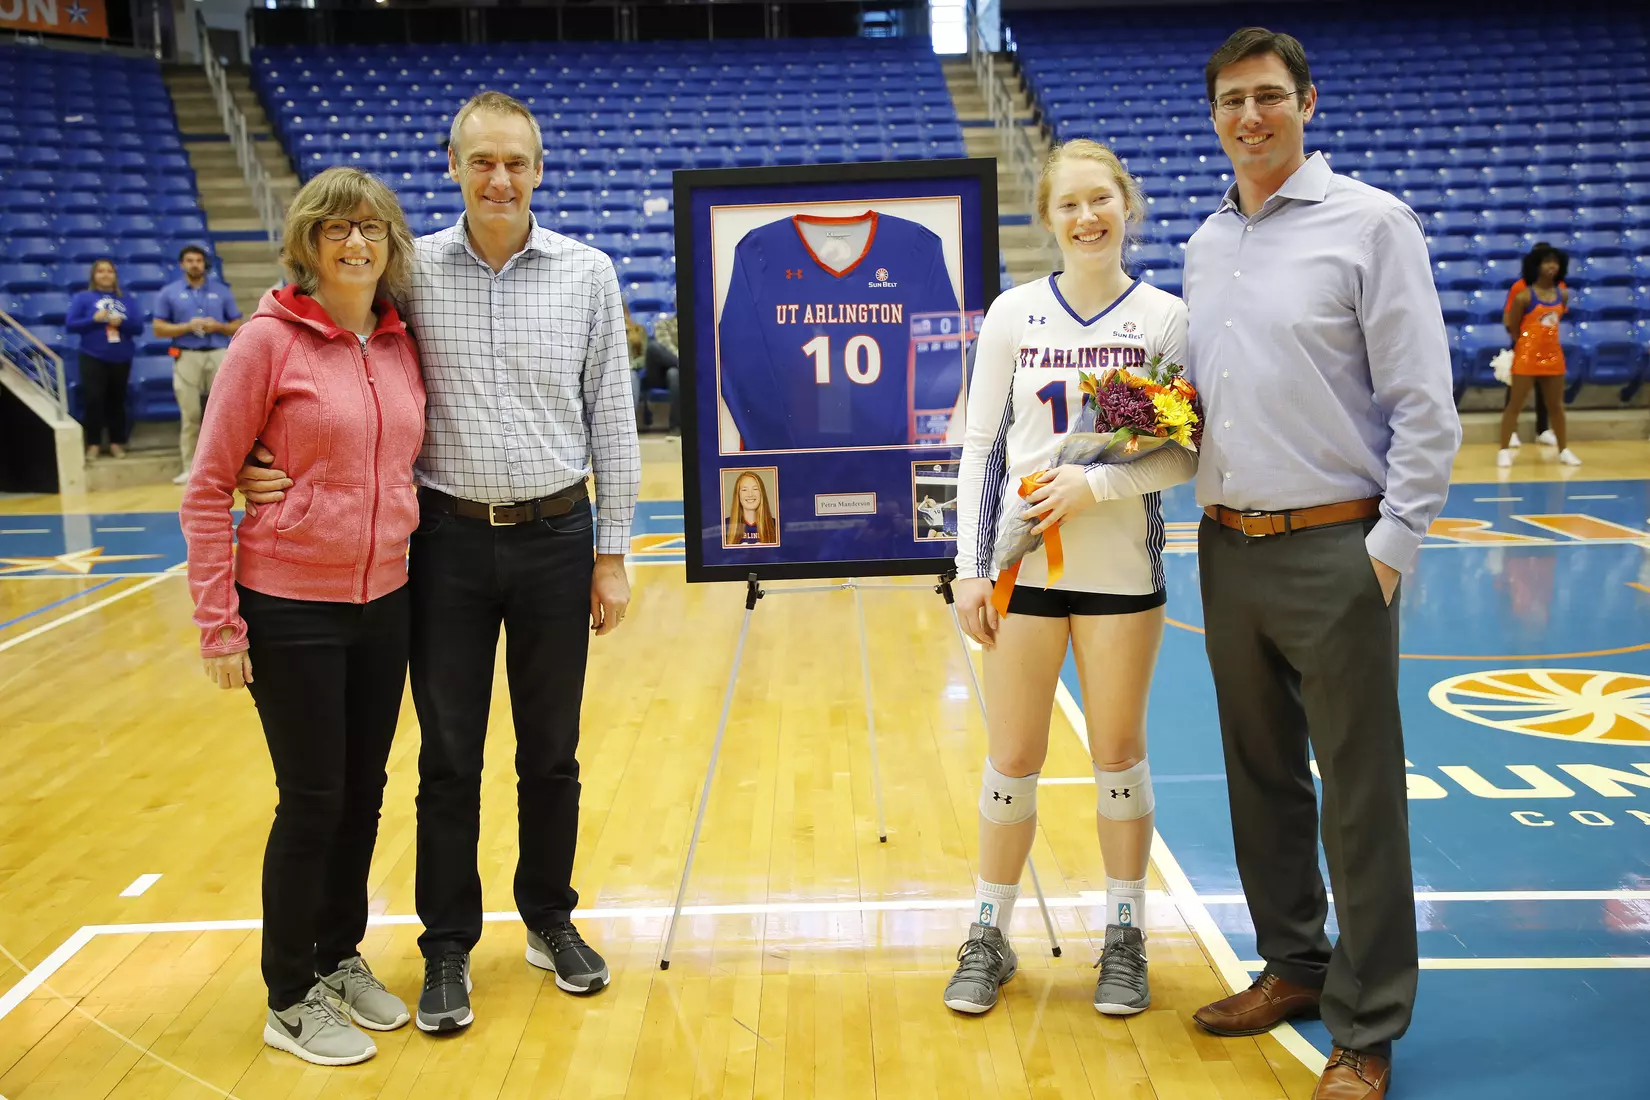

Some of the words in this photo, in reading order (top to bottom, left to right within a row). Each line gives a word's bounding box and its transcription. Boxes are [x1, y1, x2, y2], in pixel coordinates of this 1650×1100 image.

[776, 304, 799, 324] UT
[803, 303, 903, 324] ARLINGTON
[801, 333, 882, 385] 10
[1040, 347, 1146, 368] ARLINGTON
[1035, 380, 1090, 434] 1
